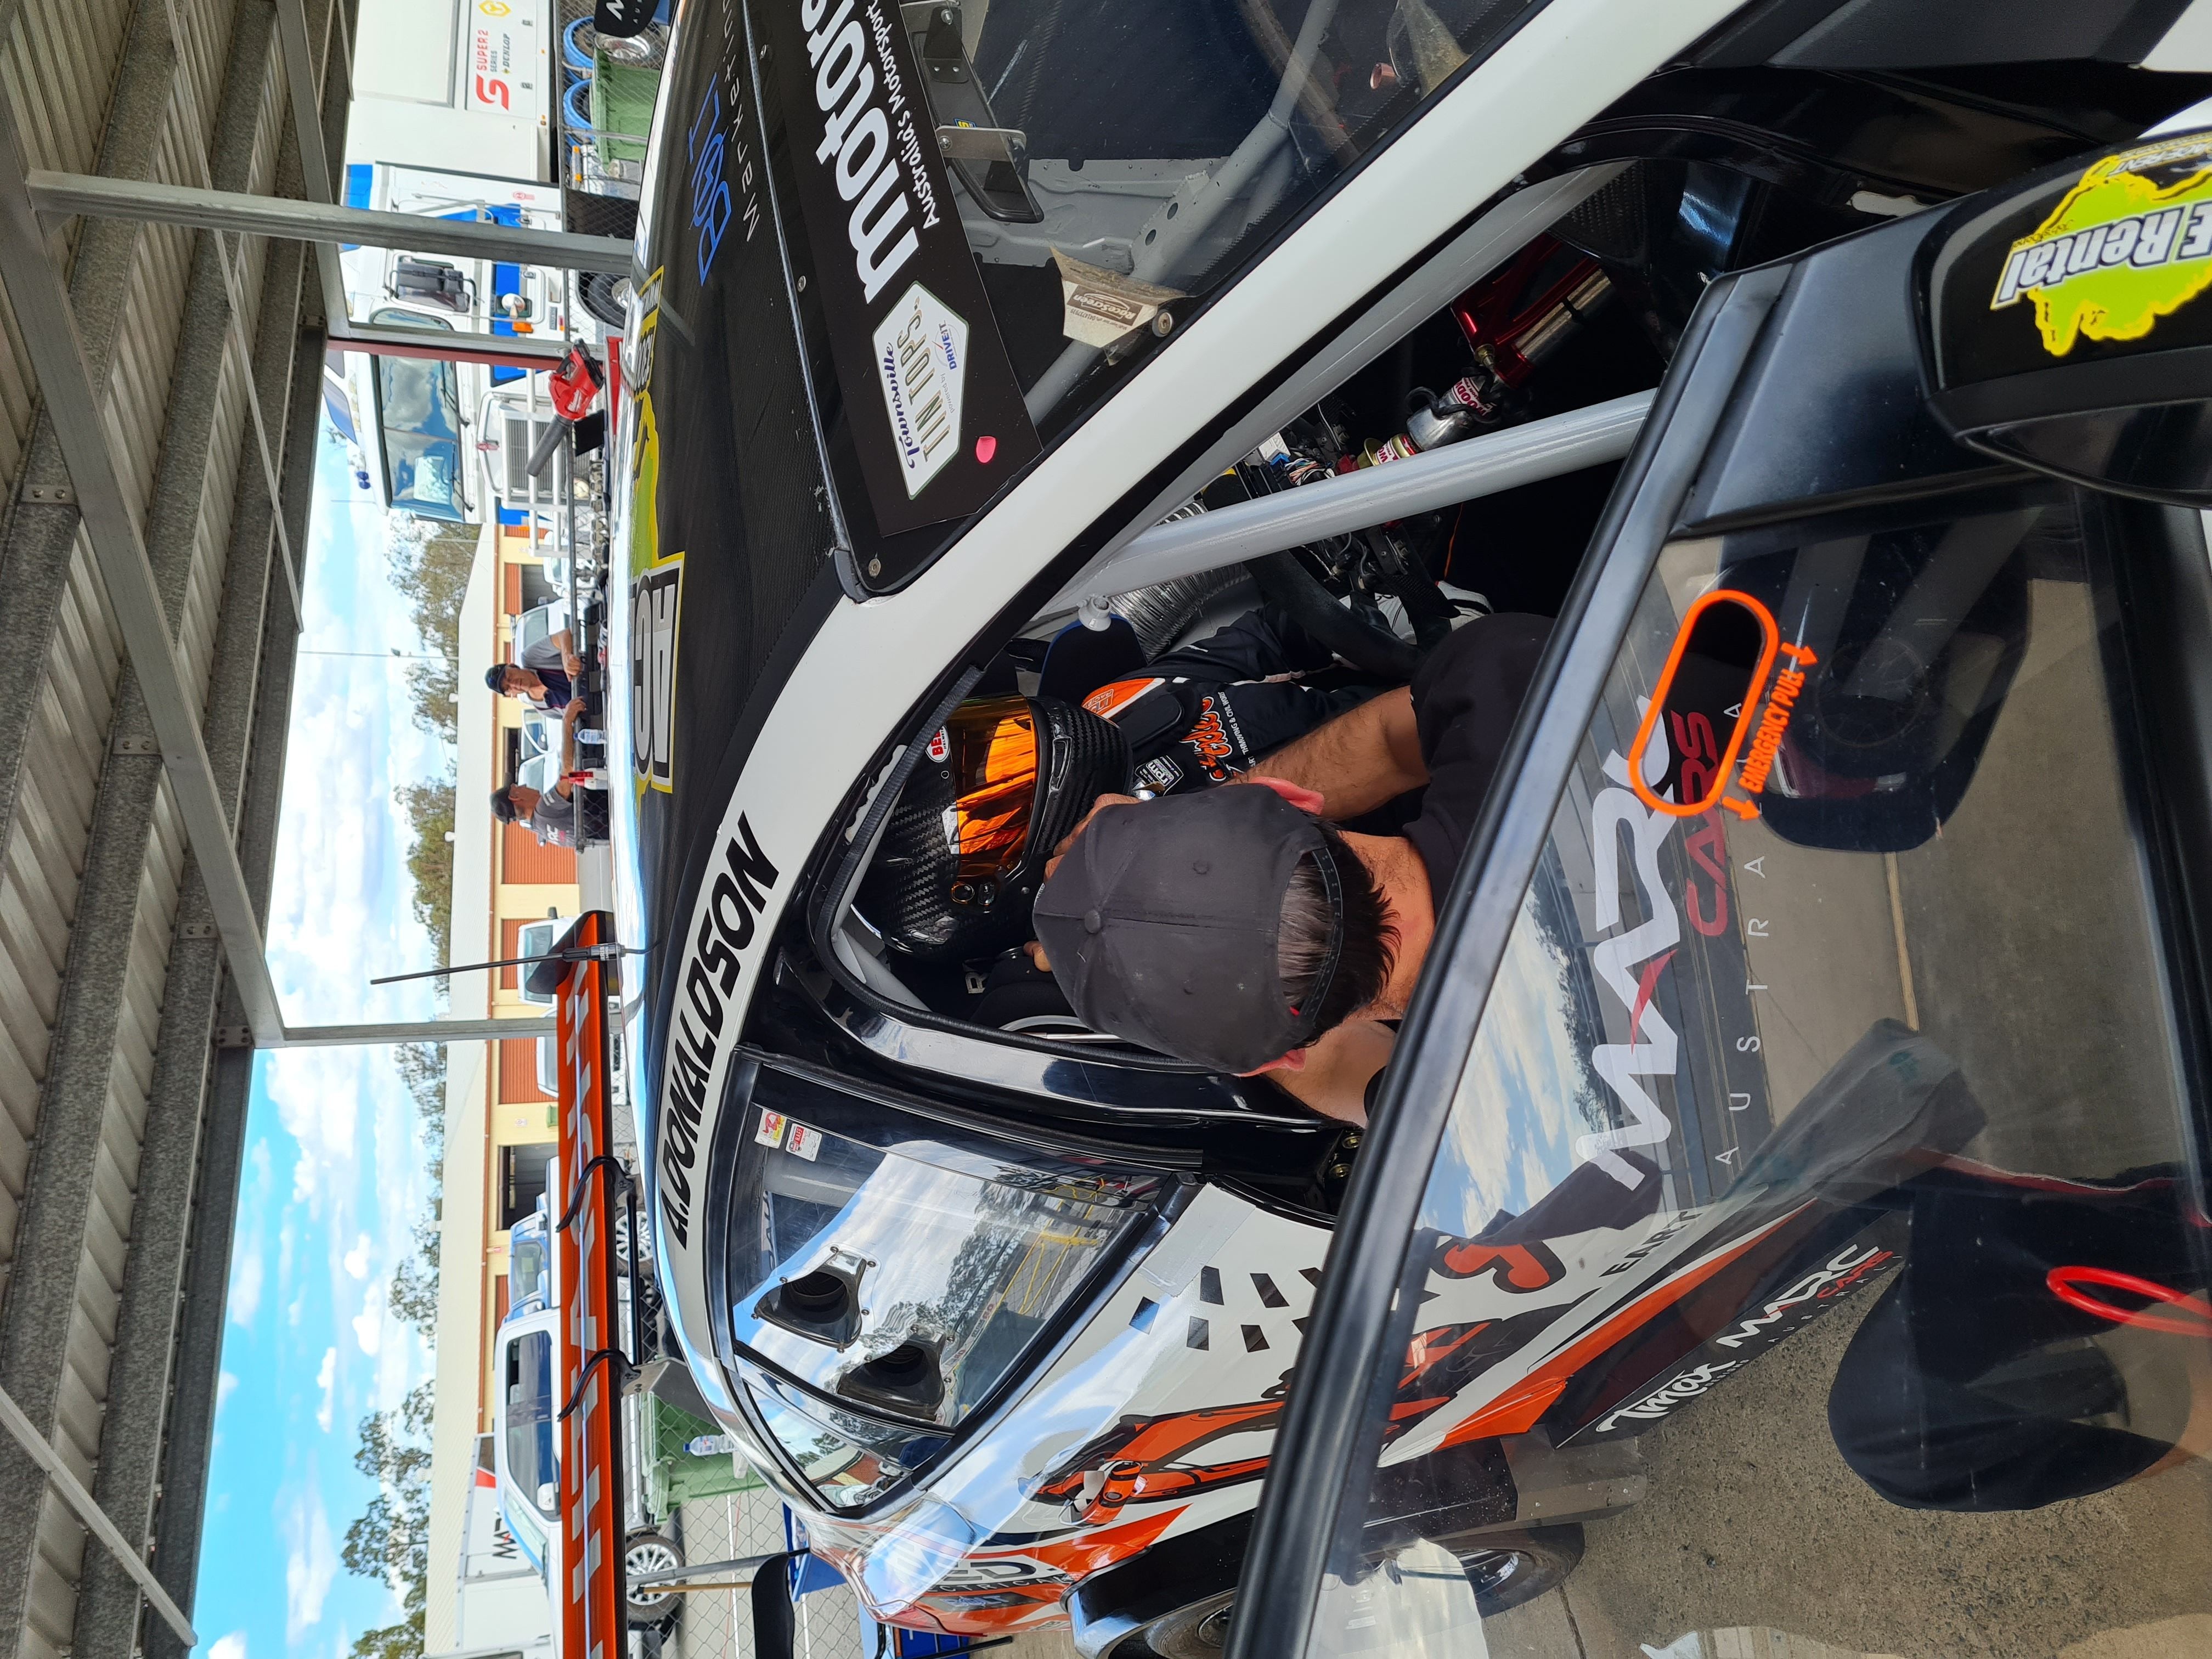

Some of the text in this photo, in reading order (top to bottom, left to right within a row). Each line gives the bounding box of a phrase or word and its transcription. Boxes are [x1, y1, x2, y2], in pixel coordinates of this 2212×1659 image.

[865, 0, 940, 228] Australia's Motorsport
[688, 71, 732, 287] BOLT
[1073, 294, 1137, 320] RaceScreen
[1996, 204, 2186, 302] Rental
[883, 342, 920, 469] Townsville
[914, 390, 951, 462] TIN
[939, 373, 956, 414] powered by
[1147, 761, 1169, 784] rpm
[1738, 668, 1805, 794] EMERGENCY PULL
[1670, 709, 1728, 936] CARS
[1575, 695, 1680, 1191] MARC
[661, 810, 780, 1251] A.DONALDSON
[1715, 1244, 1880, 1348] MARC
[1816, 1250, 1893, 1299] CARS
